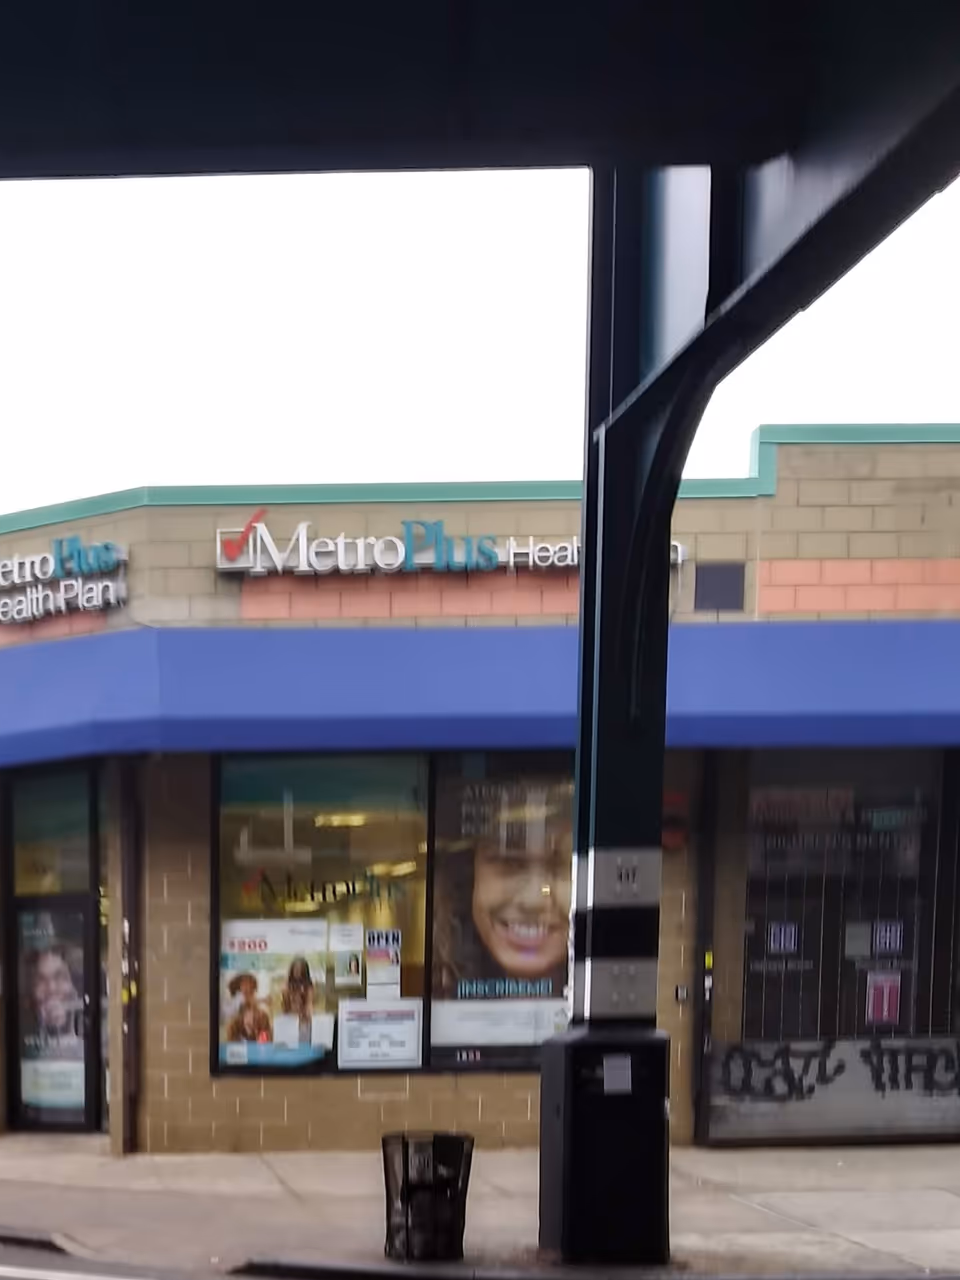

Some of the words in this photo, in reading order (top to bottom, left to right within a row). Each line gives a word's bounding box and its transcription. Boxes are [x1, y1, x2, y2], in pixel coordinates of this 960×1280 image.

[251, 519, 499, 575] MetroPlus
[508, 535, 582, 570] Heal
[56, 577, 115, 616] Plan
[367, 929, 401, 948] OPEN
